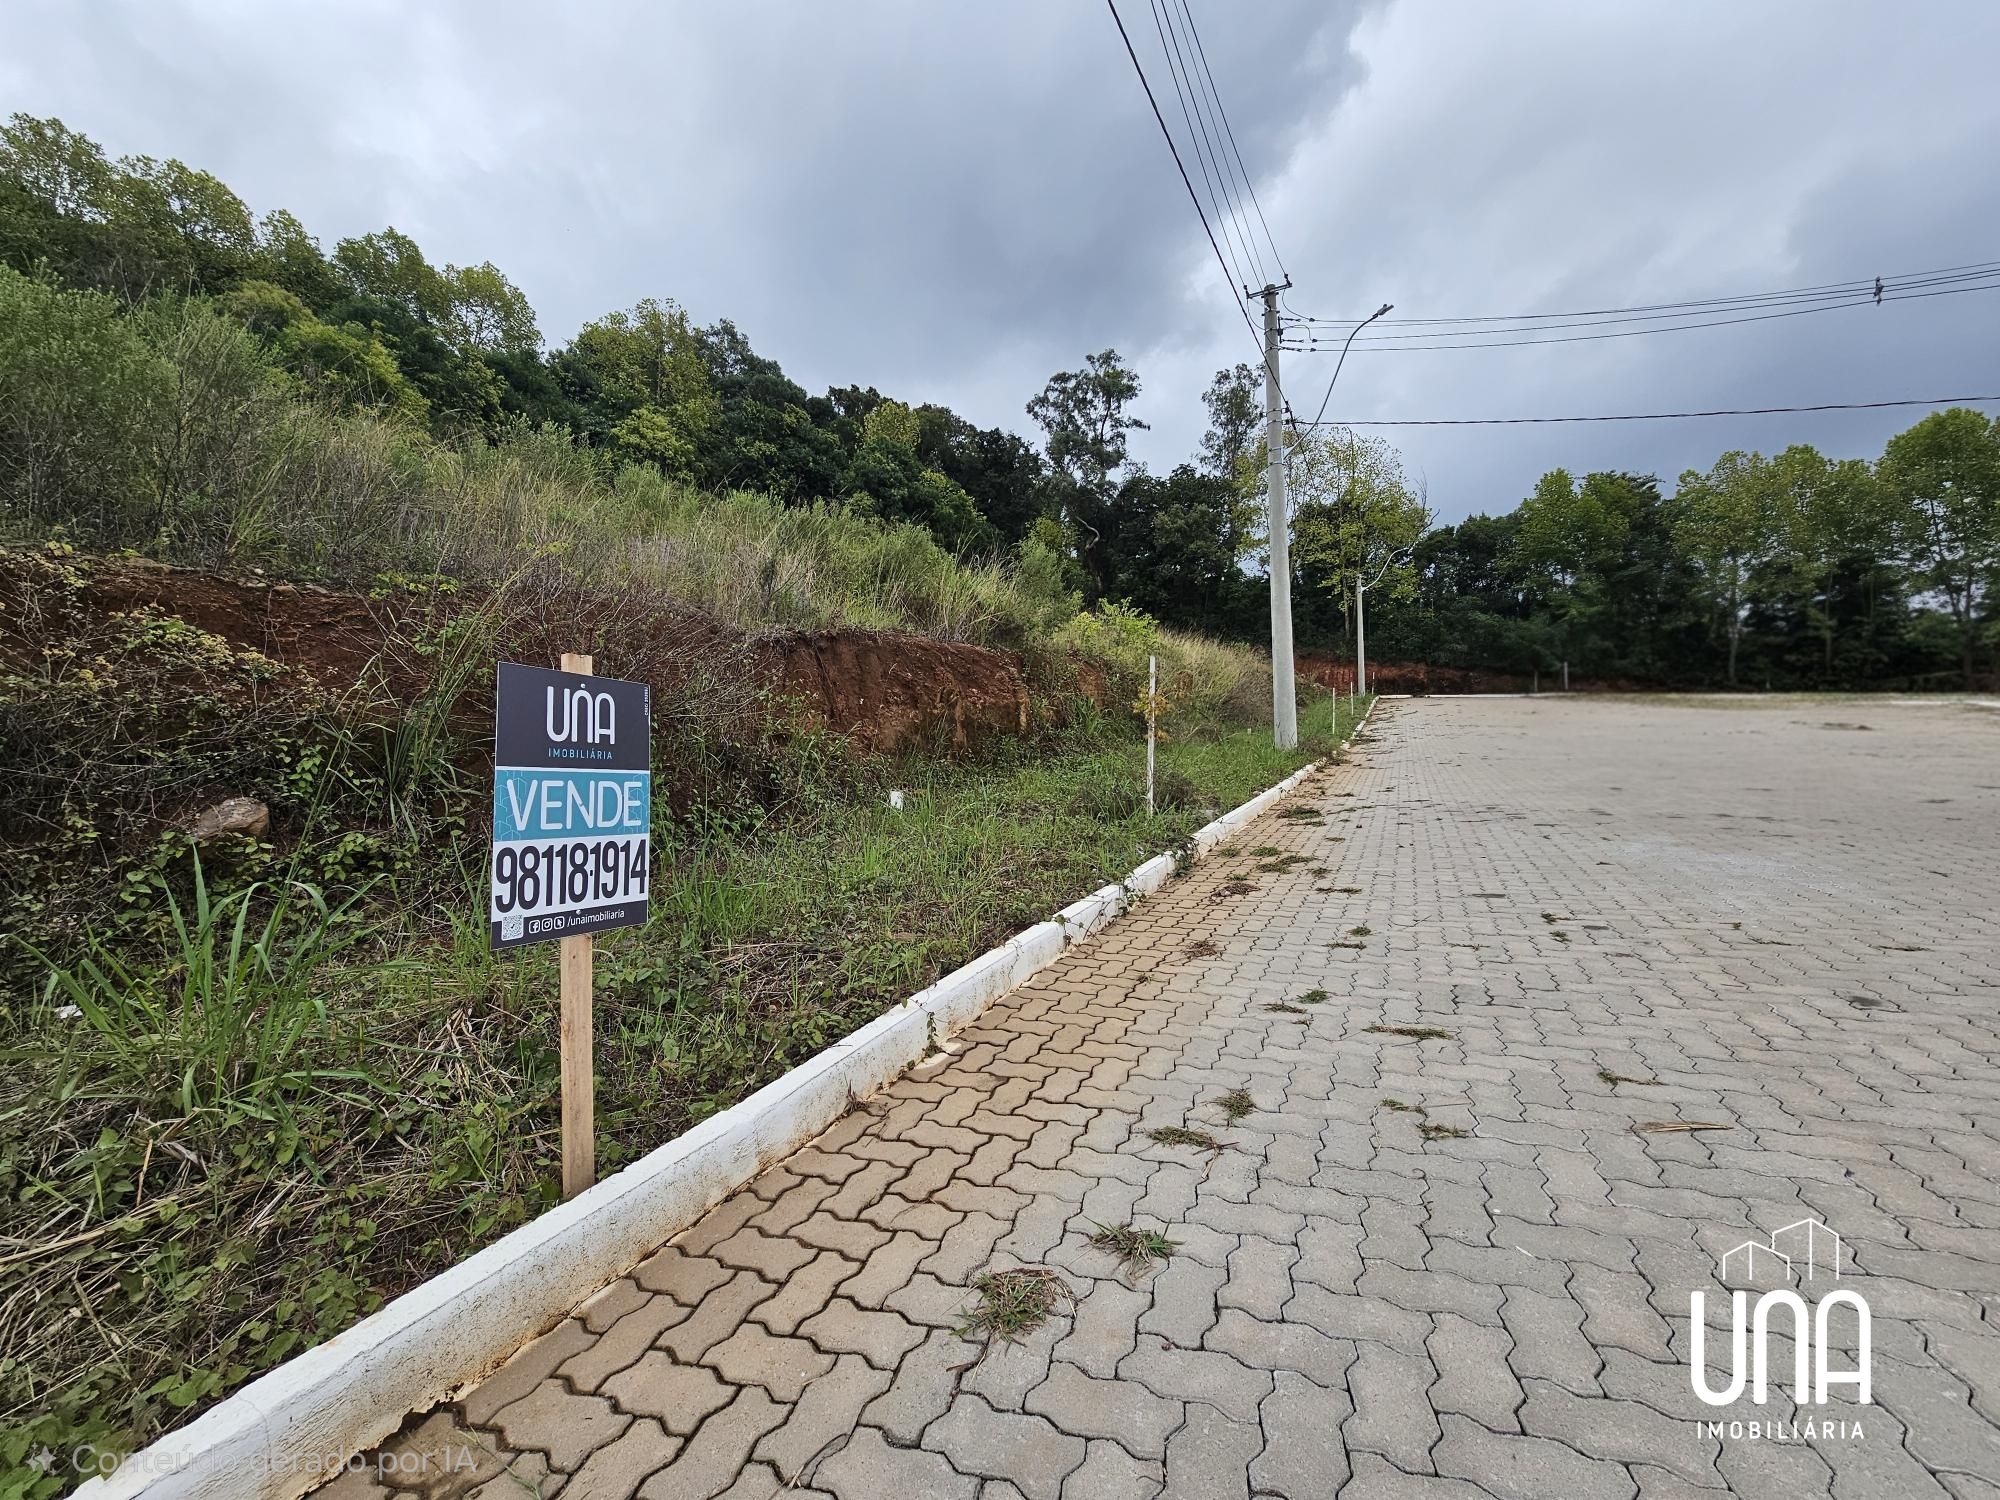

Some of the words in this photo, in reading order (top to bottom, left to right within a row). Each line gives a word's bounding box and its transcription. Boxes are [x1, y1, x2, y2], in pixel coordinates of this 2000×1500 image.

[546, 686, 616, 745] UNA
[548, 747, 613, 760] IMOBILIÁRIA
[506, 779, 643, 832] VENDE
